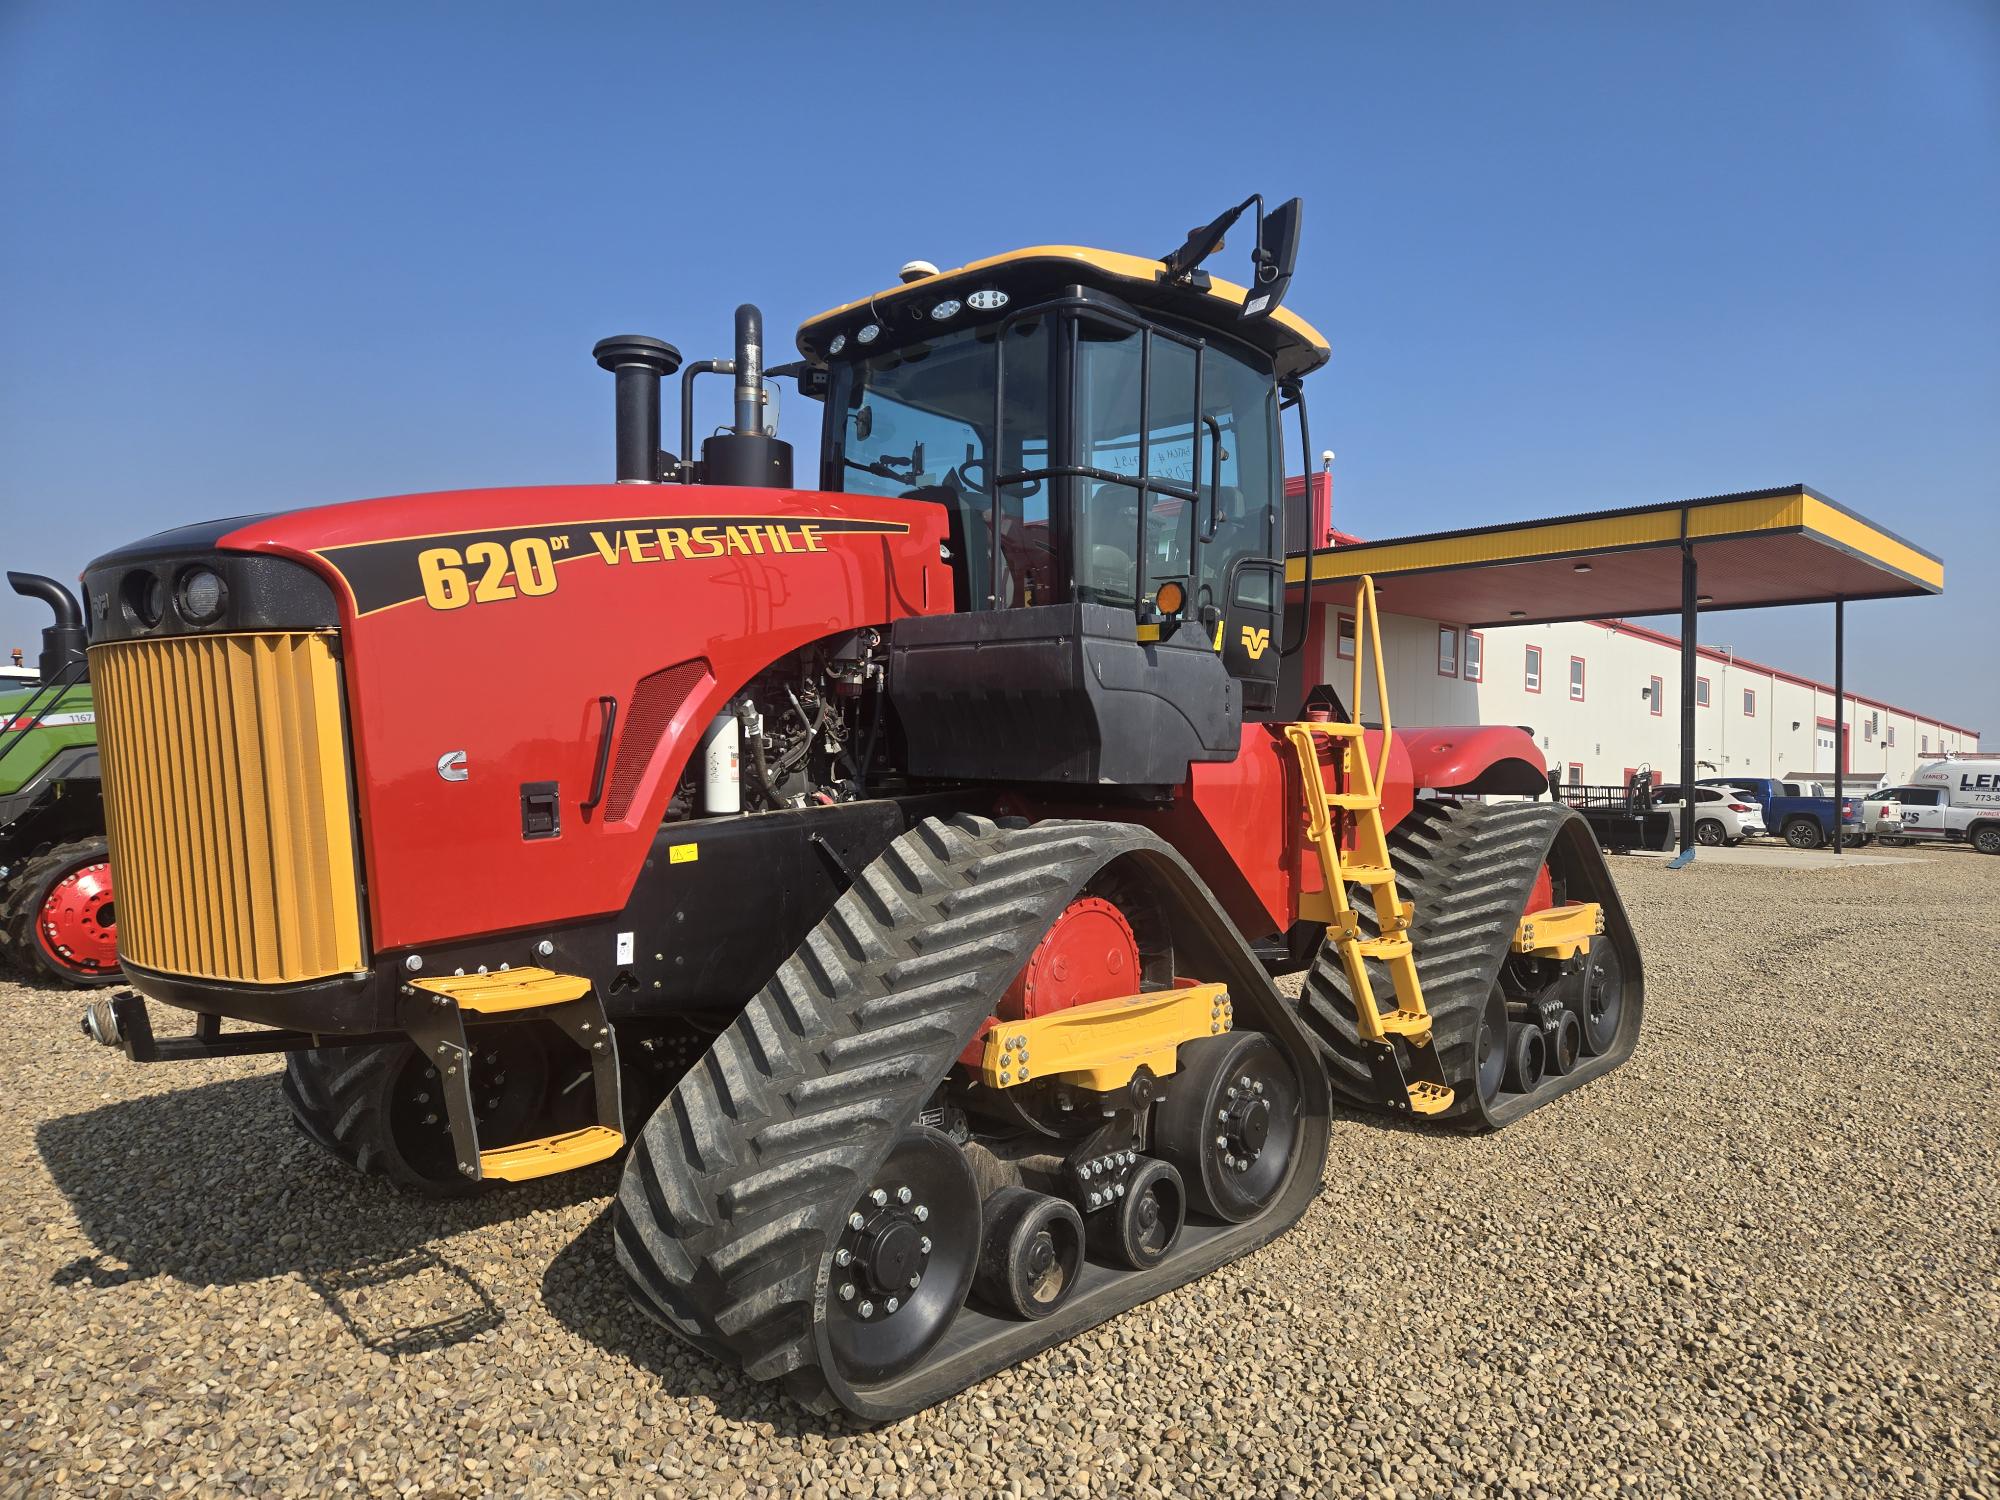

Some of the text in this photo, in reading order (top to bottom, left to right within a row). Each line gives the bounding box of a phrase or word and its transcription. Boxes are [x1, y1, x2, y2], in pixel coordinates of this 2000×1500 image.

[418, 525, 828, 610] 620 DT VERSATILE
[69, 714, 92, 722] 1167
